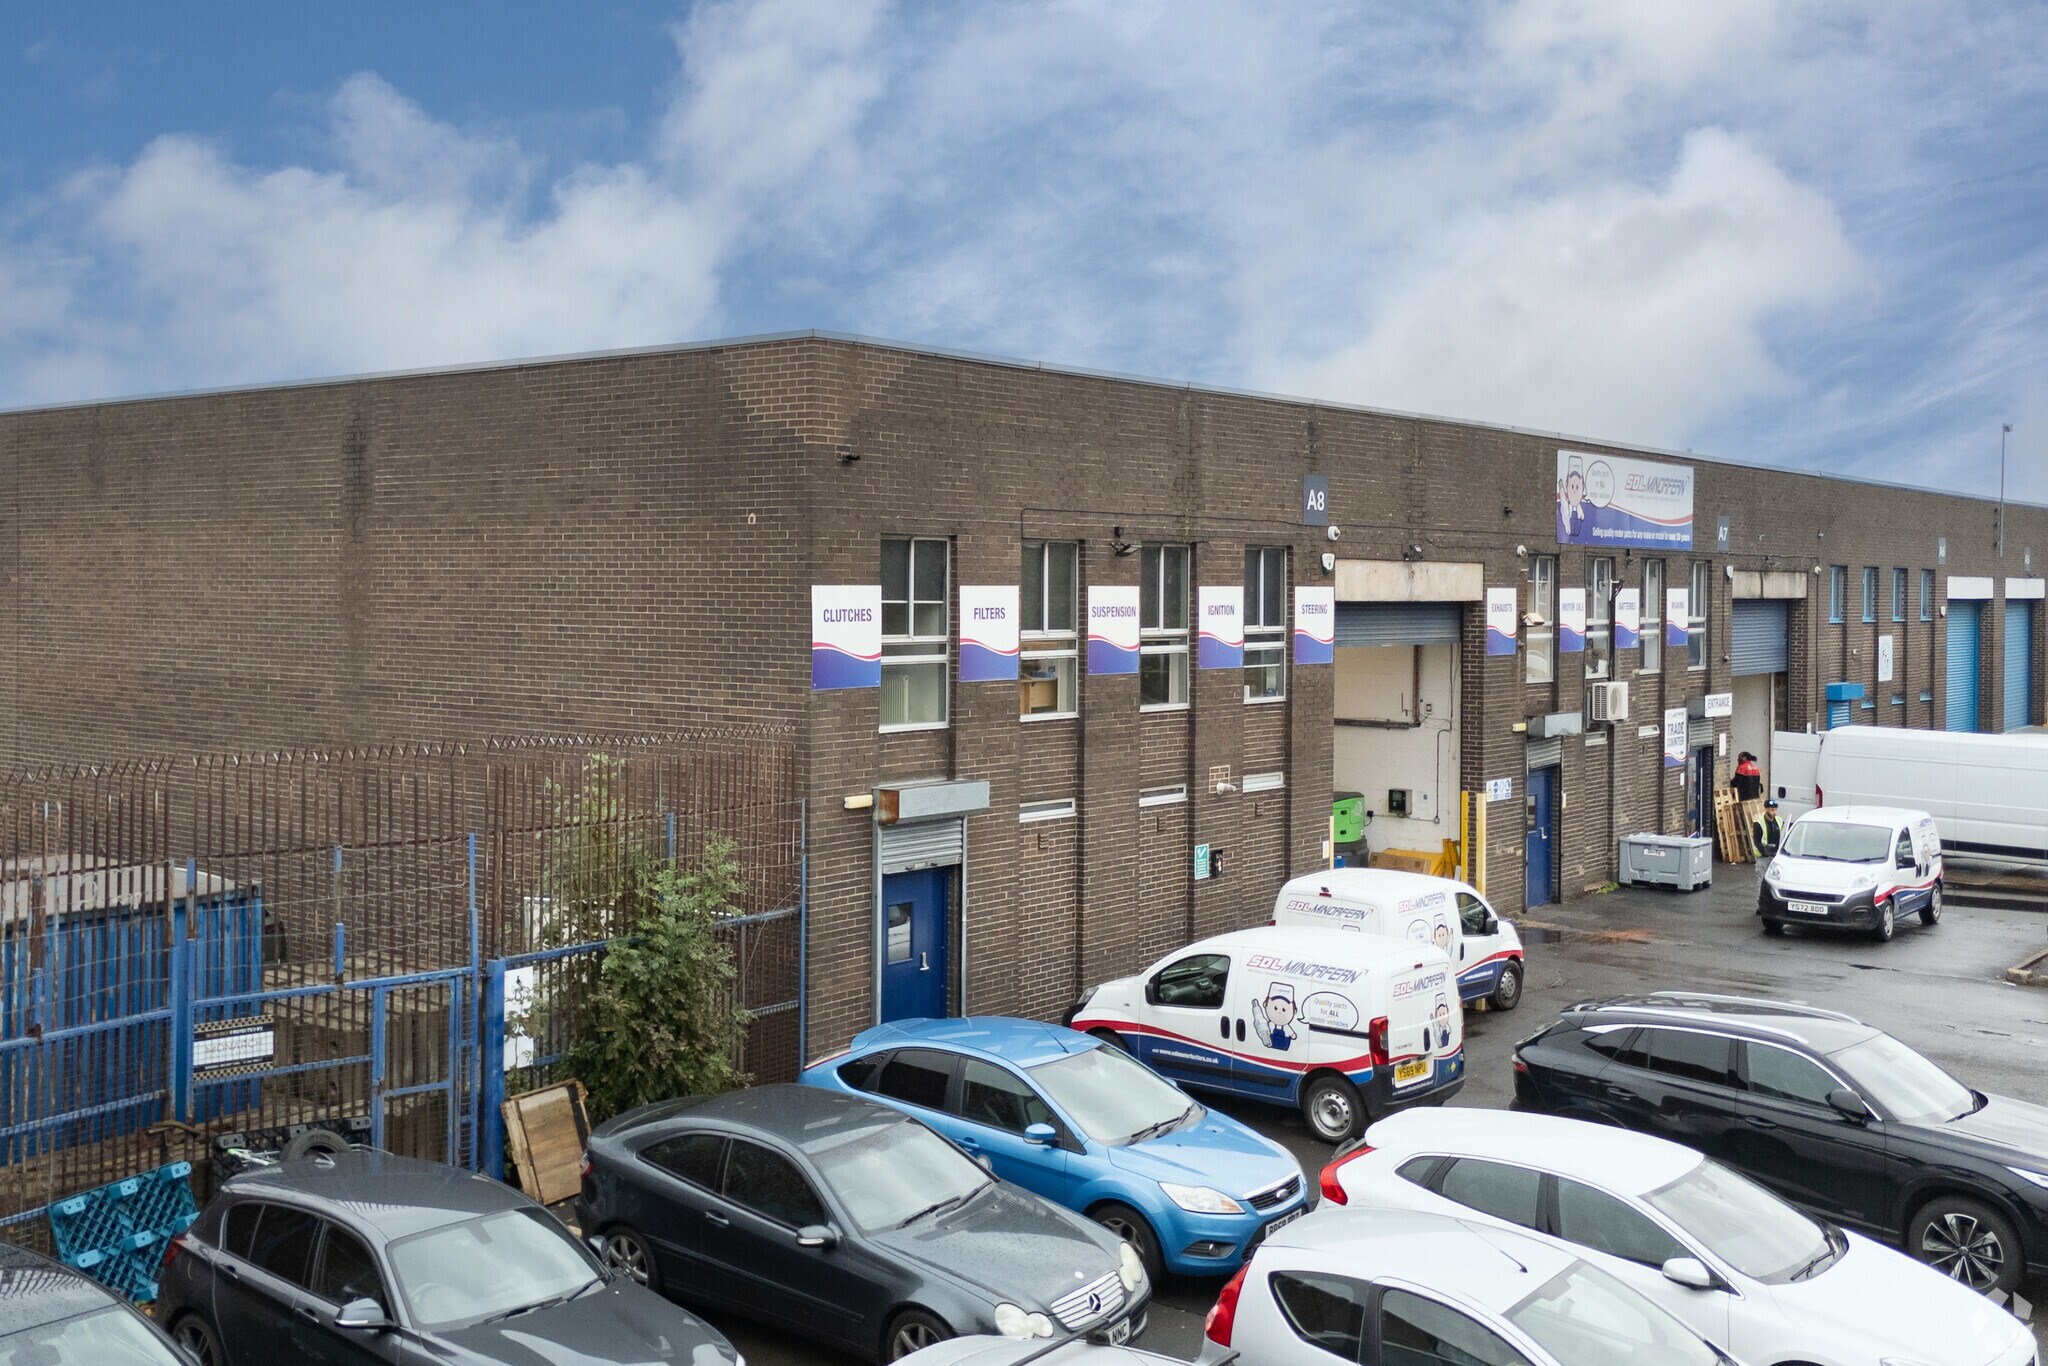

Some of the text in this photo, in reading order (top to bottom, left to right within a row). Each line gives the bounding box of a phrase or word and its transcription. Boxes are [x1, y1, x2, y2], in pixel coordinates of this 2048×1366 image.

[1624, 473, 1647, 492] SDL
[1307, 489, 1325, 511] A8
[1718, 526, 1728, 541] A7
[1091, 606, 1136, 618] SUSPENSION
[1207, 604, 1235, 616] IGNITION
[1301, 603, 1328, 615] STEERING
[1491, 603, 1513, 613] EXHAUSTS
[1562, 603, 1584, 611] MOTOR OILS
[1618, 602, 1636, 611] BATTERIES
[823, 608, 872, 623] CLUTCHES
[973, 607, 1006, 620] FILTERS
[1708, 696, 1730, 709] ENTRANCE
[1667, 721, 1685, 737] TRADE
[1667, 736, 1685, 748] COUNTER
[1397, 891, 1446, 913] SDL MINORFERN
[1286, 900, 1311, 912] SDL
[1309, 903, 1368, 920] MINORFERN
[1246, 954, 1282, 971] SDL
[1280, 959, 1362, 984] MINORFERN
[1392, 981, 1413, 997] SDL
[1412, 971, 1446, 992] MINORFERN
[1314, 997, 1348, 1010] Quality parts
[1329, 1009, 1340, 1018] ALL
[1327, 1019, 1349, 1029] vehicles
[1397, 1062, 1427, 1079] YS69 NPU
[1111, 1322, 1128, 1345] NNC
